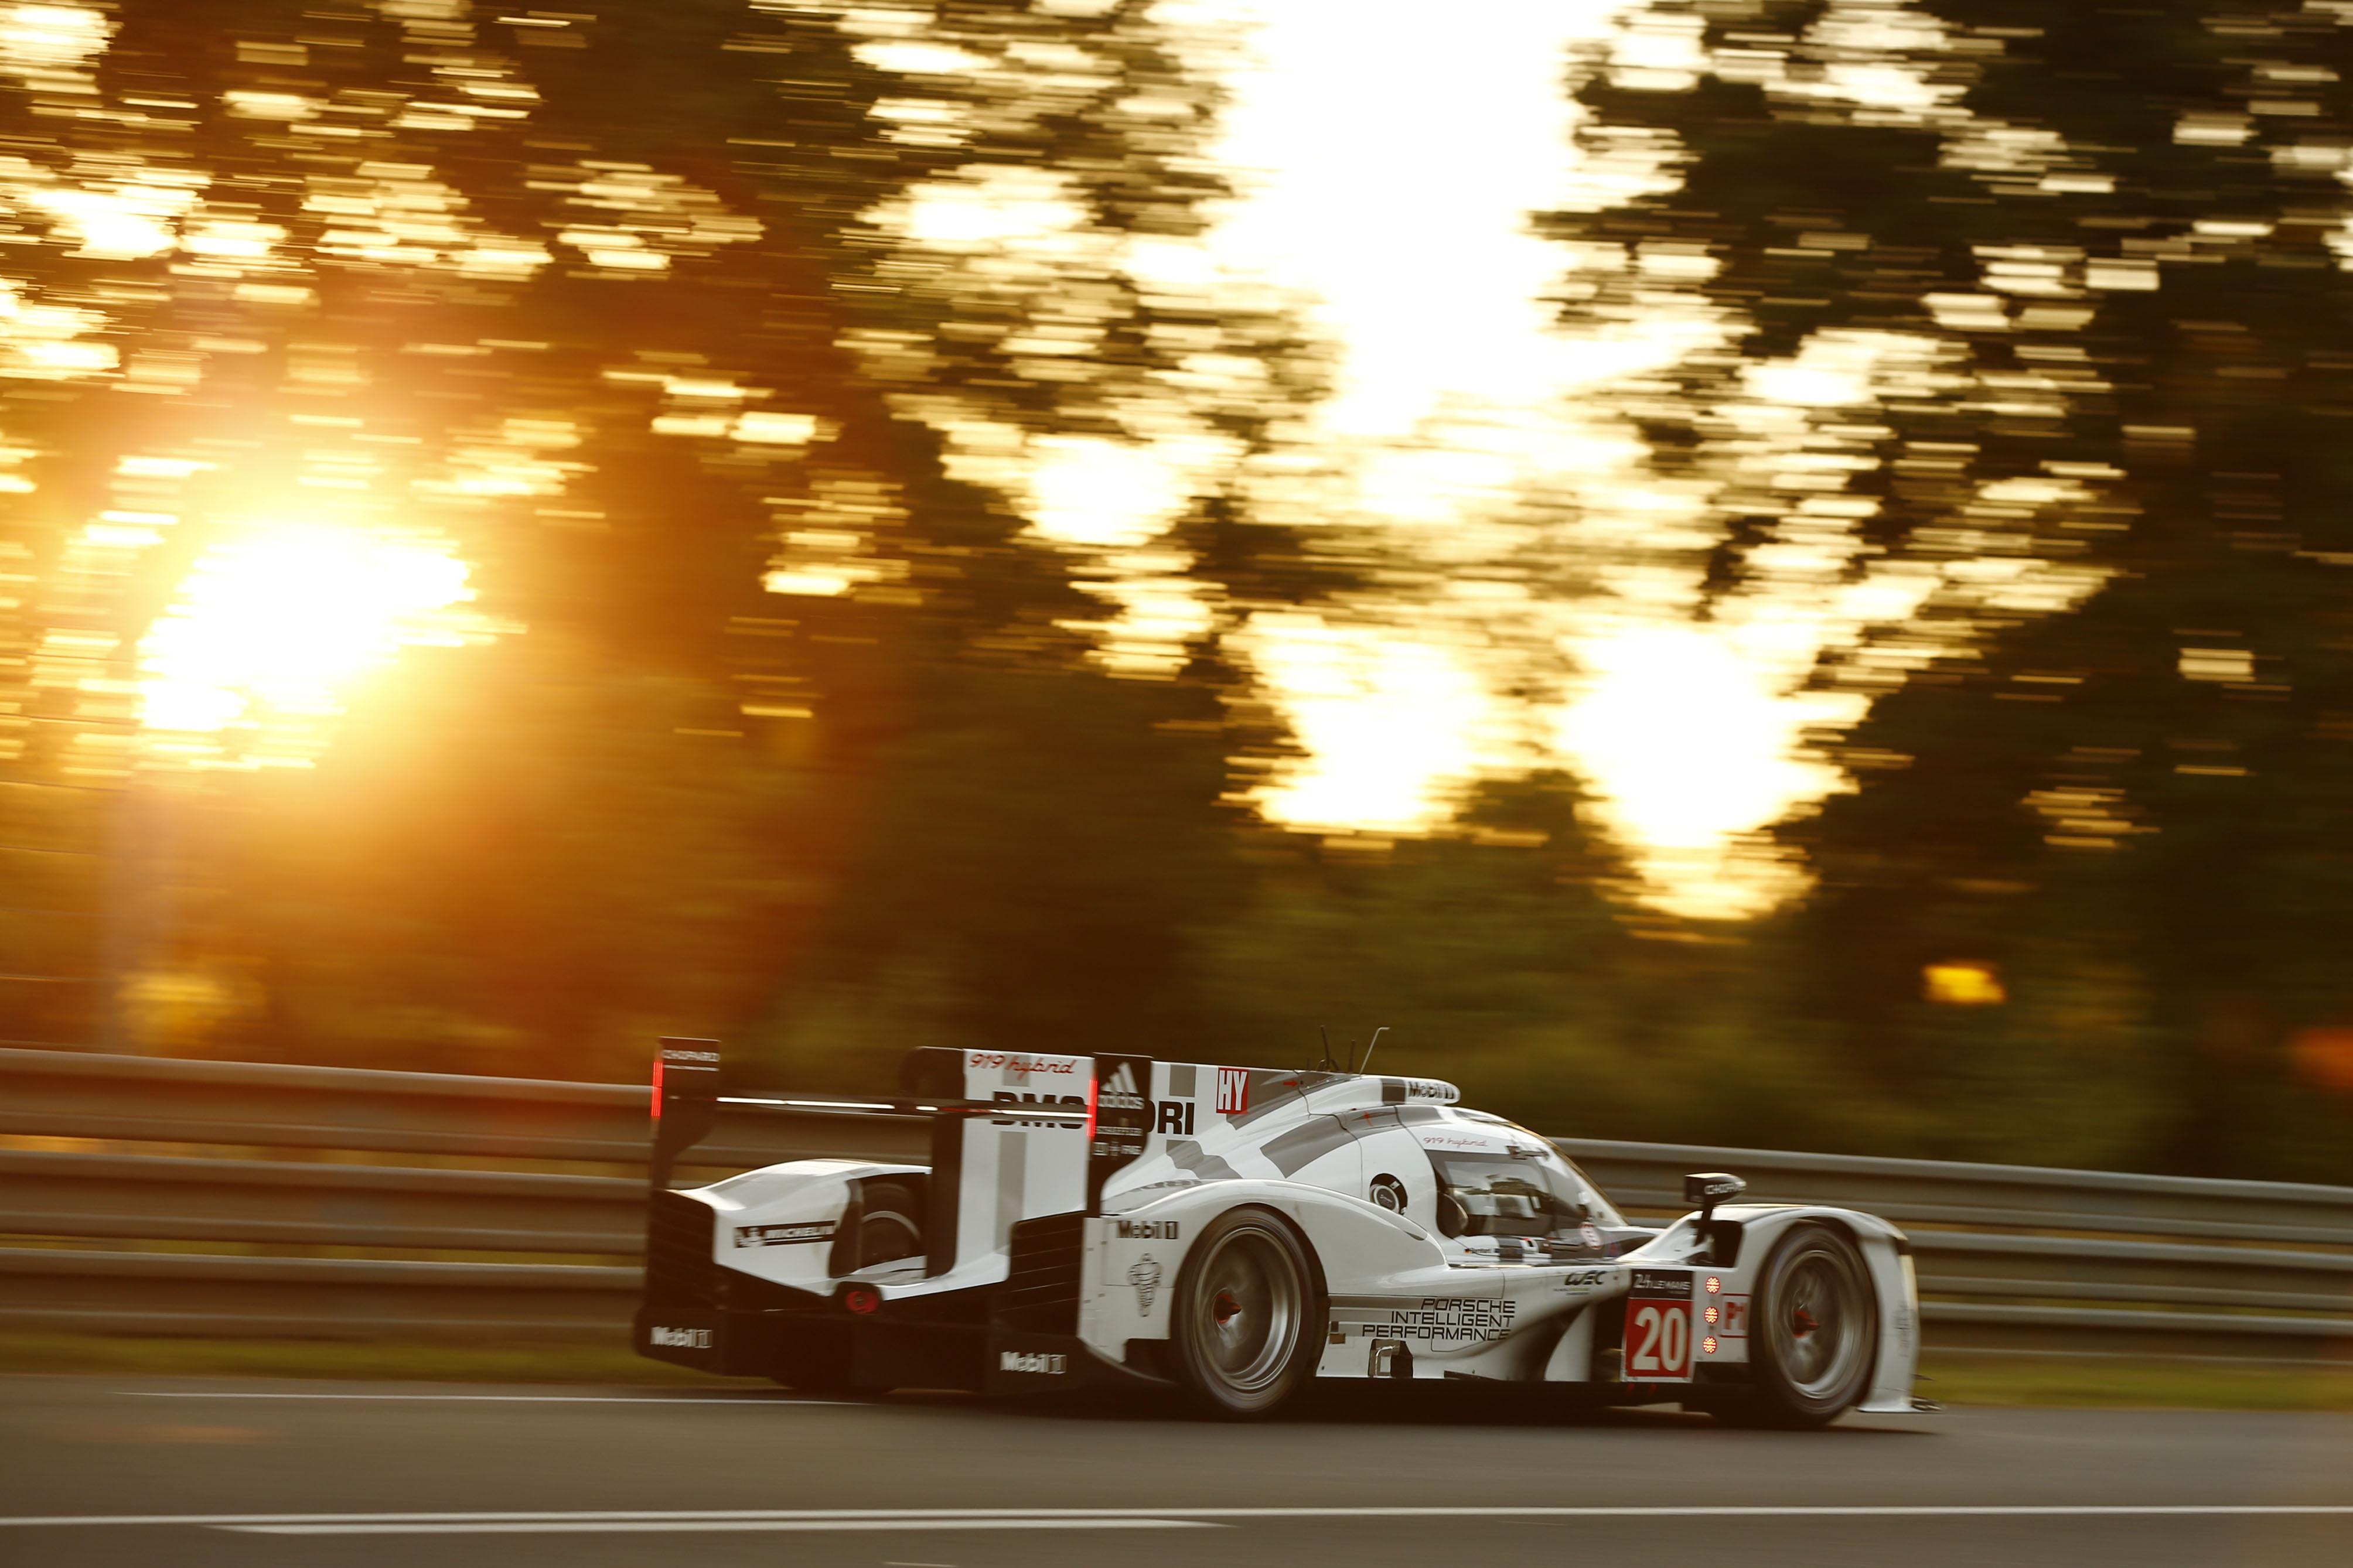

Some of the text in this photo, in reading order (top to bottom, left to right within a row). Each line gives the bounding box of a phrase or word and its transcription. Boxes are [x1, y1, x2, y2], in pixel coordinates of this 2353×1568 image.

[970, 1054, 1077, 1081] 919 hybrid
[1218, 1070, 1247, 1111] HY
[1097, 1092, 1144, 1109] adidas
[1447, 1137, 1489, 1148] hybrid
[1116, 1220, 1161, 1239] Mobil
[1564, 1270, 1607, 1286] WEC
[1421, 1298, 1516, 1314] PORSCHE
[1391, 1311, 1515, 1327] INTELLIGENT
[650, 1326, 697, 1347] Mobil
[1362, 1324, 1512, 1341] PERFORMANCE
[1632, 1307, 1688, 1371] 20
[1000, 1351, 1049, 1373] Mobil
